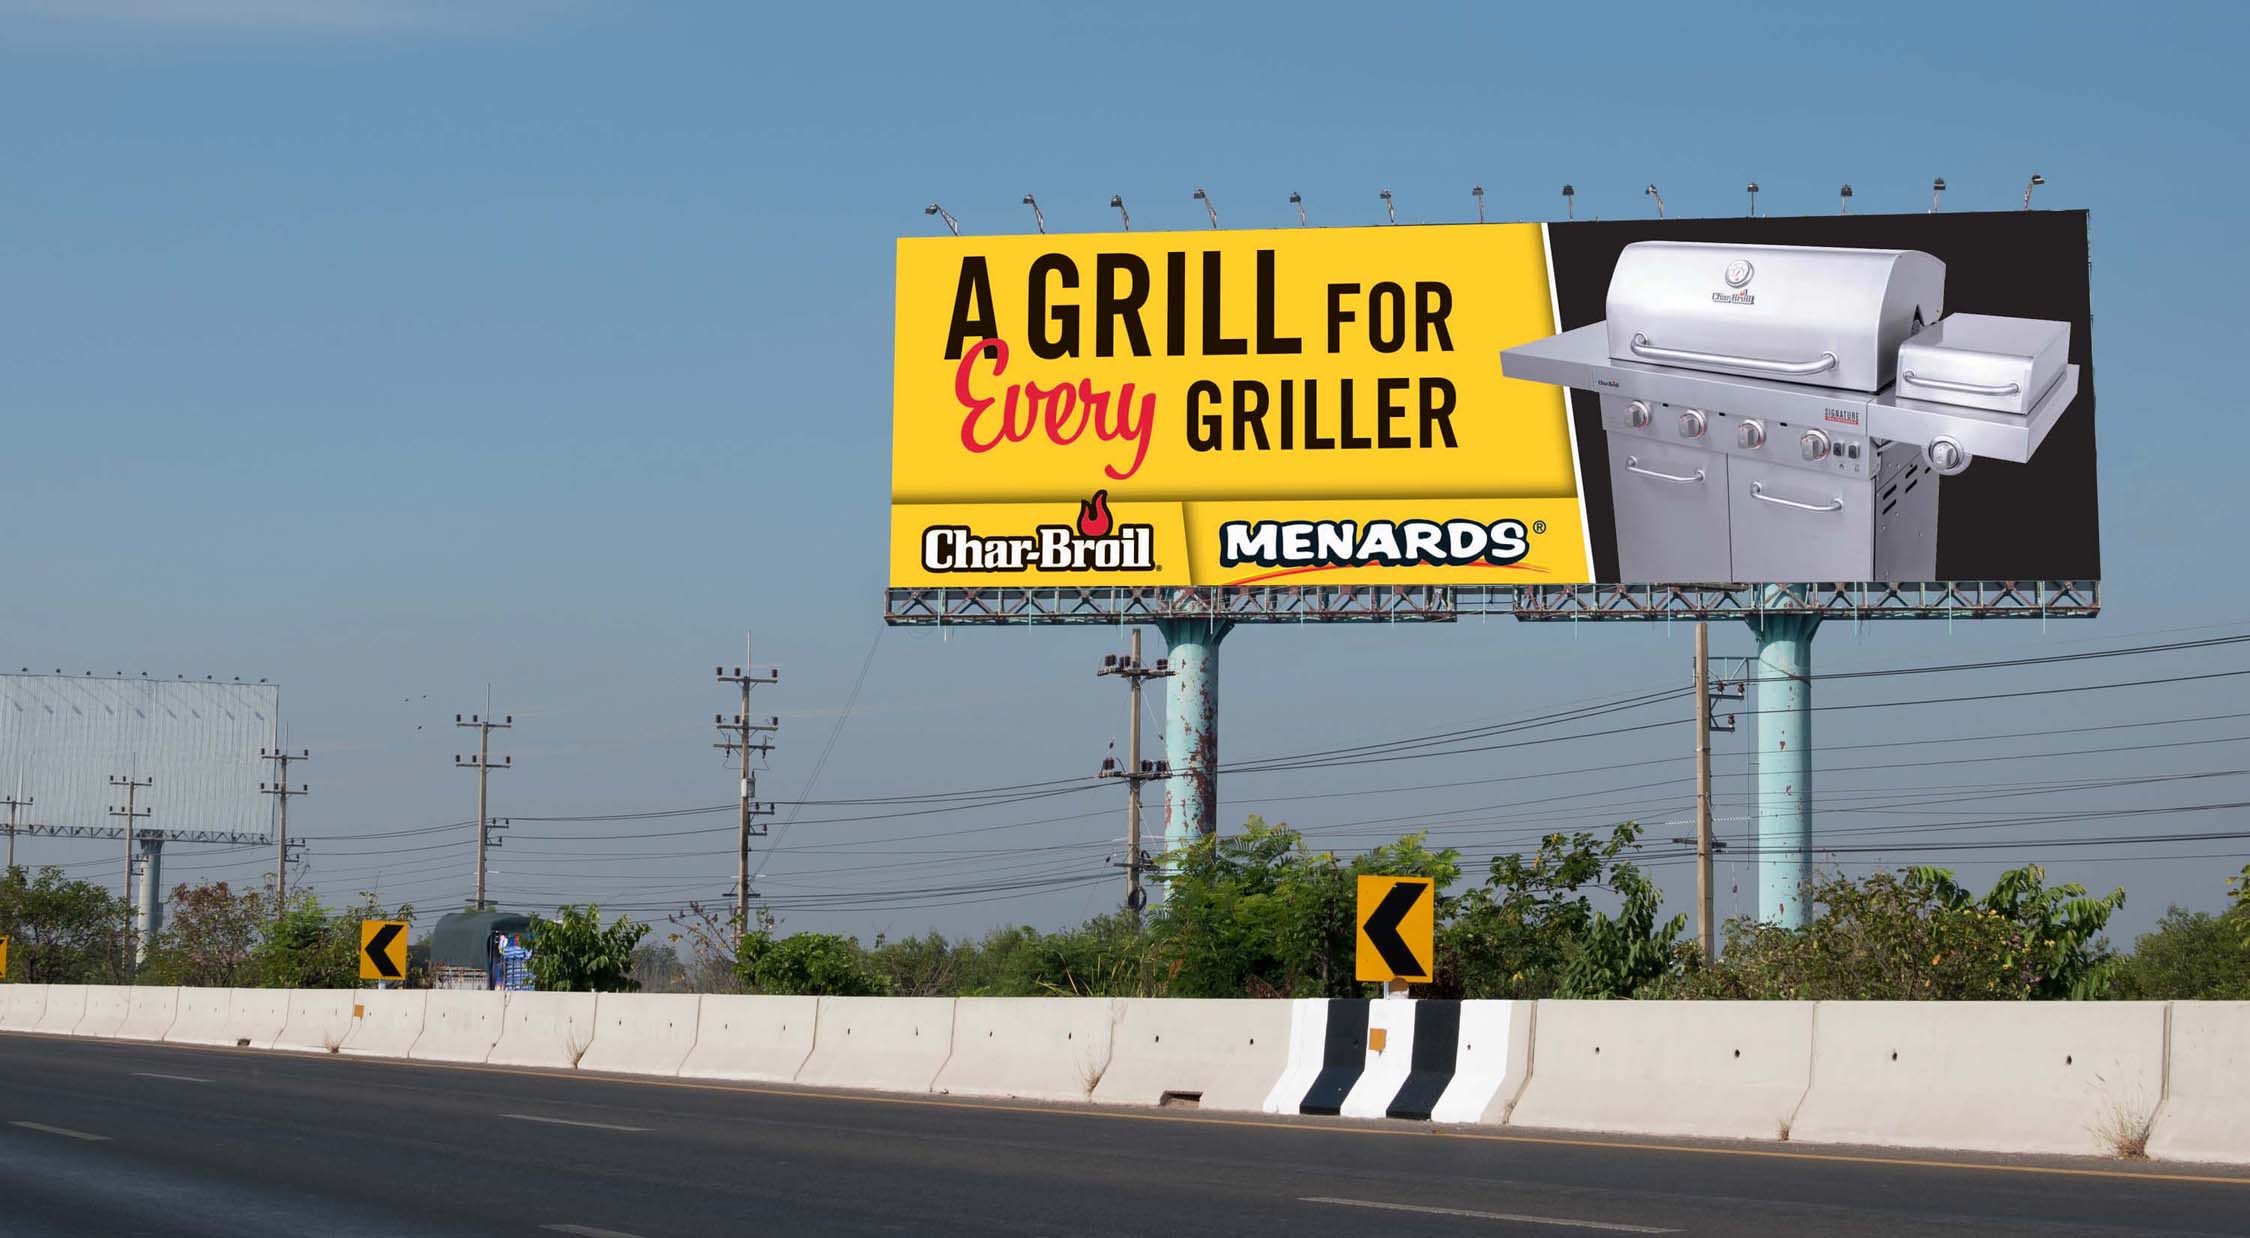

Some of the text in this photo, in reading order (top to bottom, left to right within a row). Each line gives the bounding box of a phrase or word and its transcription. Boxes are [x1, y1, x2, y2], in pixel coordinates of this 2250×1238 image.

[944, 249, 1454, 360] A GRILL FOR
[955, 338, 1458, 481] Every GRILLER
[924, 527, 1153, 571] Char-Broil
[1221, 520, 1529, 567] MENARDS
